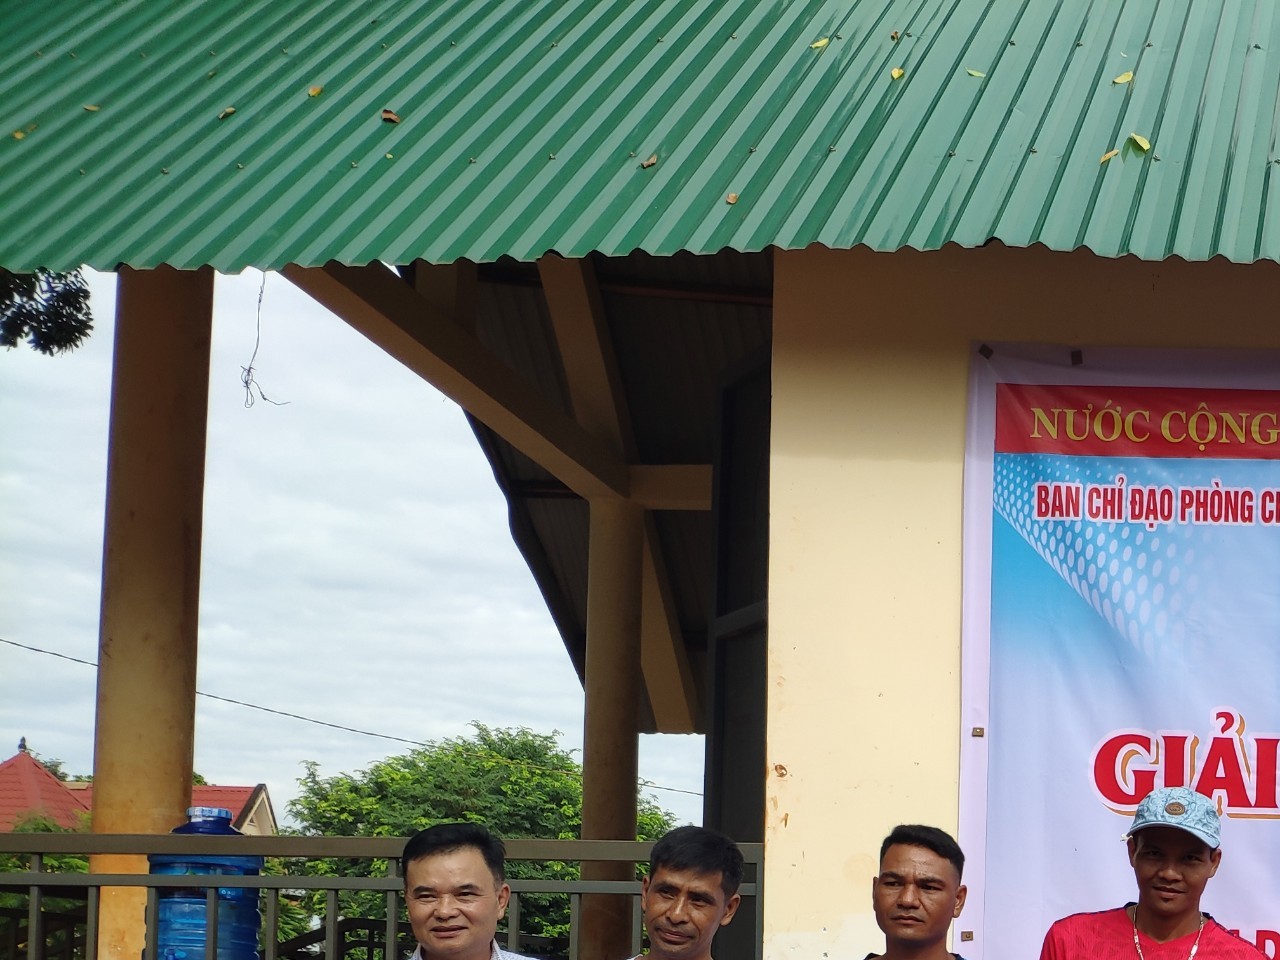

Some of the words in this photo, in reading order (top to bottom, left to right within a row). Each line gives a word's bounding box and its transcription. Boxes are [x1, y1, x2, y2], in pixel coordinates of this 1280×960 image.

[1031, 400, 1150, 442] NƯỚC
[1161, 403, 1280, 450] CỘNG
[1036, 485, 1081, 518] BAN
[1088, 476, 1125, 520] CHỈ
[1130, 489, 1173, 528] ĐẠO
[1180, 479, 1254, 523] PHÒNG
